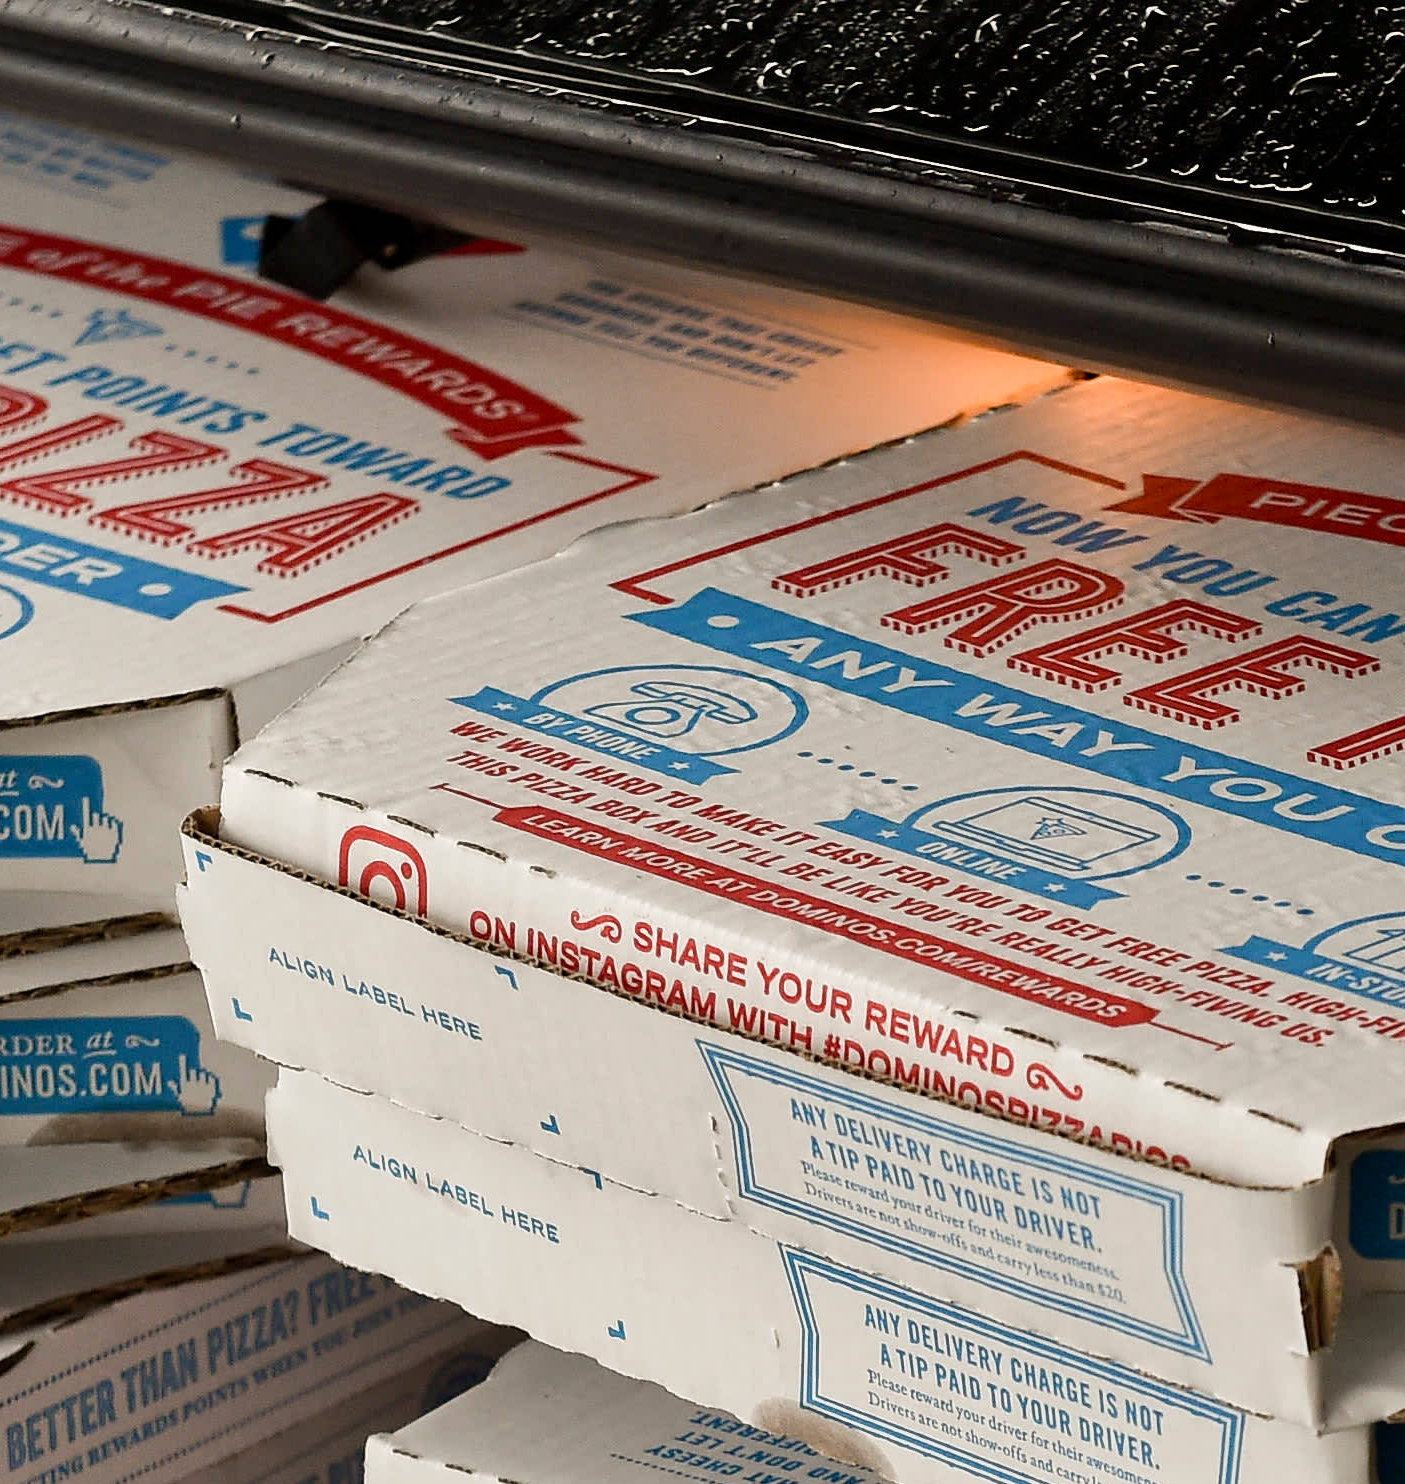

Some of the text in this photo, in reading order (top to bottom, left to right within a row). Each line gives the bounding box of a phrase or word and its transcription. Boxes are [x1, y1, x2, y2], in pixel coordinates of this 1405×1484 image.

[28, 245, 93, 275] of
[97, 250, 170, 296] the
[178, 271, 280, 323] PIE
[52, 363, 265, 435] POINTS
[263, 421, 512, 501] TOWARD
[968, 498, 1149, 554] NOW
[1131, 545, 1277, 597] YOU
[771, 522, 1381, 730] FREE
[524, 712, 662, 761] BY PHONE
[752, 636, 956, 695] ANY
[956, 695, 1154, 757] WAY
[1161, 756, 1354, 823] YOU
[449, 721, 500, 744] WE
[497, 732, 582, 769] WORK
[579, 755, 661, 795] HARD
[655, 782, 702, 803] TO
[692, 796, 785, 834] MAKE
[780, 822, 817, 845] IT
[807, 836, 886, 872] EASY
[882, 860, 947, 890] FOR
[948, 879, 1013, 909] YOU
[1009, 899, 1051, 920] TO
[1044, 909, 1115, 944] GET
[1109, 929, 1197, 971] FREE
[1186, 952, 1270, 998] PIZZA,
[522, 814, 1127, 1020] LEARN MORE AT DOMINOS.COM/REWARDS
[914, 841, 1031, 880] ONLINE
[634, 922, 1016, 1077] SHARE YOUR REWARD
[354, 1145, 560, 1244] ALIGN LABEL HERE
[5, 1379, 116, 1469] BETTER
[122, 1339, 197, 1420] THAN
[208, 1290, 301, 1377] PIZZA?
[864, 1304, 1164, 1435] ANY DELIVERY CHARGE IS NOT
[868, 1370, 907, 1396] Please
[910, 1385, 953, 1415] reward
[956, 1404, 985, 1430] your
[988, 1412, 1026, 1440] driver
[1031, 1425, 1049, 1447] for
[1052, 1434, 1082, 1464] their
[868, 1391, 916, 1425] Drivers
[918, 1412, 938, 1431] are
[942, 1419, 962, 1439] not
[965, 1423, 1027, 1465] show-offs
[1031, 1454, 1053, 1474] and
[880, 1343, 1161, 1470] A TIP PAID TO YOUR DRIVER.
